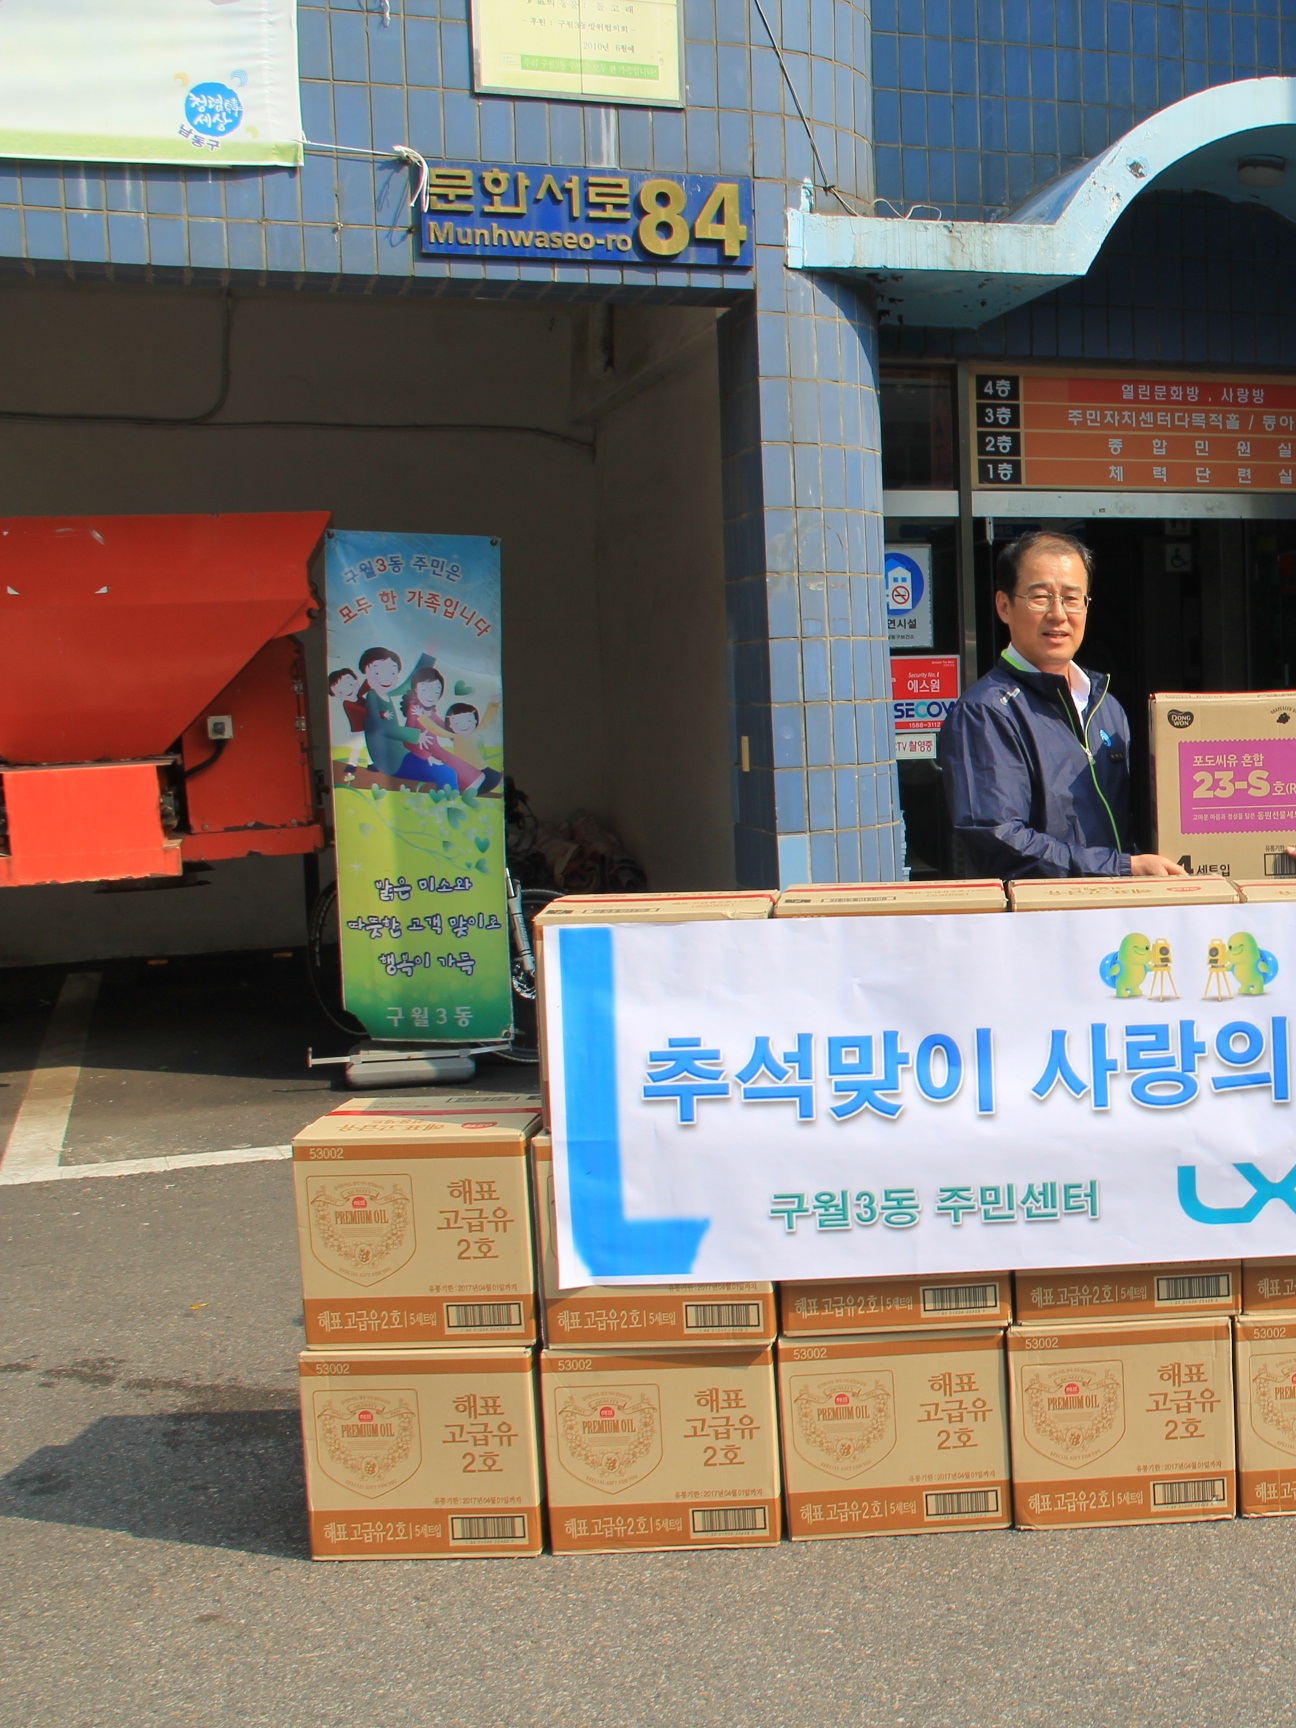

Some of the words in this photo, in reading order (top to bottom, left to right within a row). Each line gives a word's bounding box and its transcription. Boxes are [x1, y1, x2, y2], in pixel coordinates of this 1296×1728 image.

[178, 123, 220, 151] 남동구
[428, 168, 631, 219] 문화서로
[638, 179, 747, 257] 84
[428, 221, 632, 251] Munhwaseo-ro
[983, 379, 1011, 397] 4층
[1221, 388, 1265, 404] 사랑방
[985, 406, 1011, 424] 3층
[985, 435, 1012, 452] 2층
[987, 463, 1013, 480] 1층
[343, 553, 403, 584] 구월3동
[412, 556, 461, 582] 주민은
[338, 596, 372, 624] 모두
[379, 590, 397, 612] 한
[407, 590, 492, 637] 가족입니다
[888, 619, 916, 629] 연시설
[908, 679, 940, 693] 에스원
[1193, 754, 1238, 768] 포도씨유
[1241, 754, 1264, 767] 혼합
[1192, 770, 1270, 798] 23-S
[1196, 864, 1230, 876] 세트입
[375, 876, 412, 901] 밝은
[418, 876, 472, 893] 미소와
[347, 915, 401, 939] 따뜻한
[407, 914, 442, 935] 고객
[448, 913, 502, 937] 맞이로
[378, 952, 431, 976] 행복이
[438, 954, 475, 976] 가득
[386, 1006, 473, 1028] 구월3동
[642, 1027, 997, 1126] 추석맞이
[1030, 1014, 1291, 1111] 사랑의
[309, 1147, 344, 1160] 53002
[447, 1178, 499, 1205] 해표
[335, 1210, 373, 1225] PREMIUM
[374, 1209, 389, 1224] OIL
[768, 1186, 923, 1233] 구월3동
[934, 1179, 1100, 1226] 주민센터
[436, 1207, 514, 1233] 고급유
[457, 1238, 499, 1260] 2호
[1254, 1327, 1286, 1339] 53002
[558, 1359, 592, 1371] 53002
[793, 1348, 827, 1360] 53002
[316, 1363, 350, 1374] 53002
[928, 1371, 979, 1397] 해표
[453, 1393, 504, 1419] 해표
[694, 1388, 747, 1413] 해표
[917, 1397, 993, 1424] 고급유
[817, 1406, 854, 1422] PREMIUM
[855, 1405, 870, 1419] OIL
[341, 1423, 379, 1438] PREMIUM
[380, 1423, 394, 1437] OIL
[442, 1421, 519, 1447] 고급유
[583, 1420, 620, 1434] PREMIUM
[621, 1419, 636, 1433] OIL
[683, 1414, 760, 1440] 고급유
[937, 1427, 978, 1450] 2호
[462, 1451, 503, 1474] 2호
[703, 1444, 745, 1467] 2호
